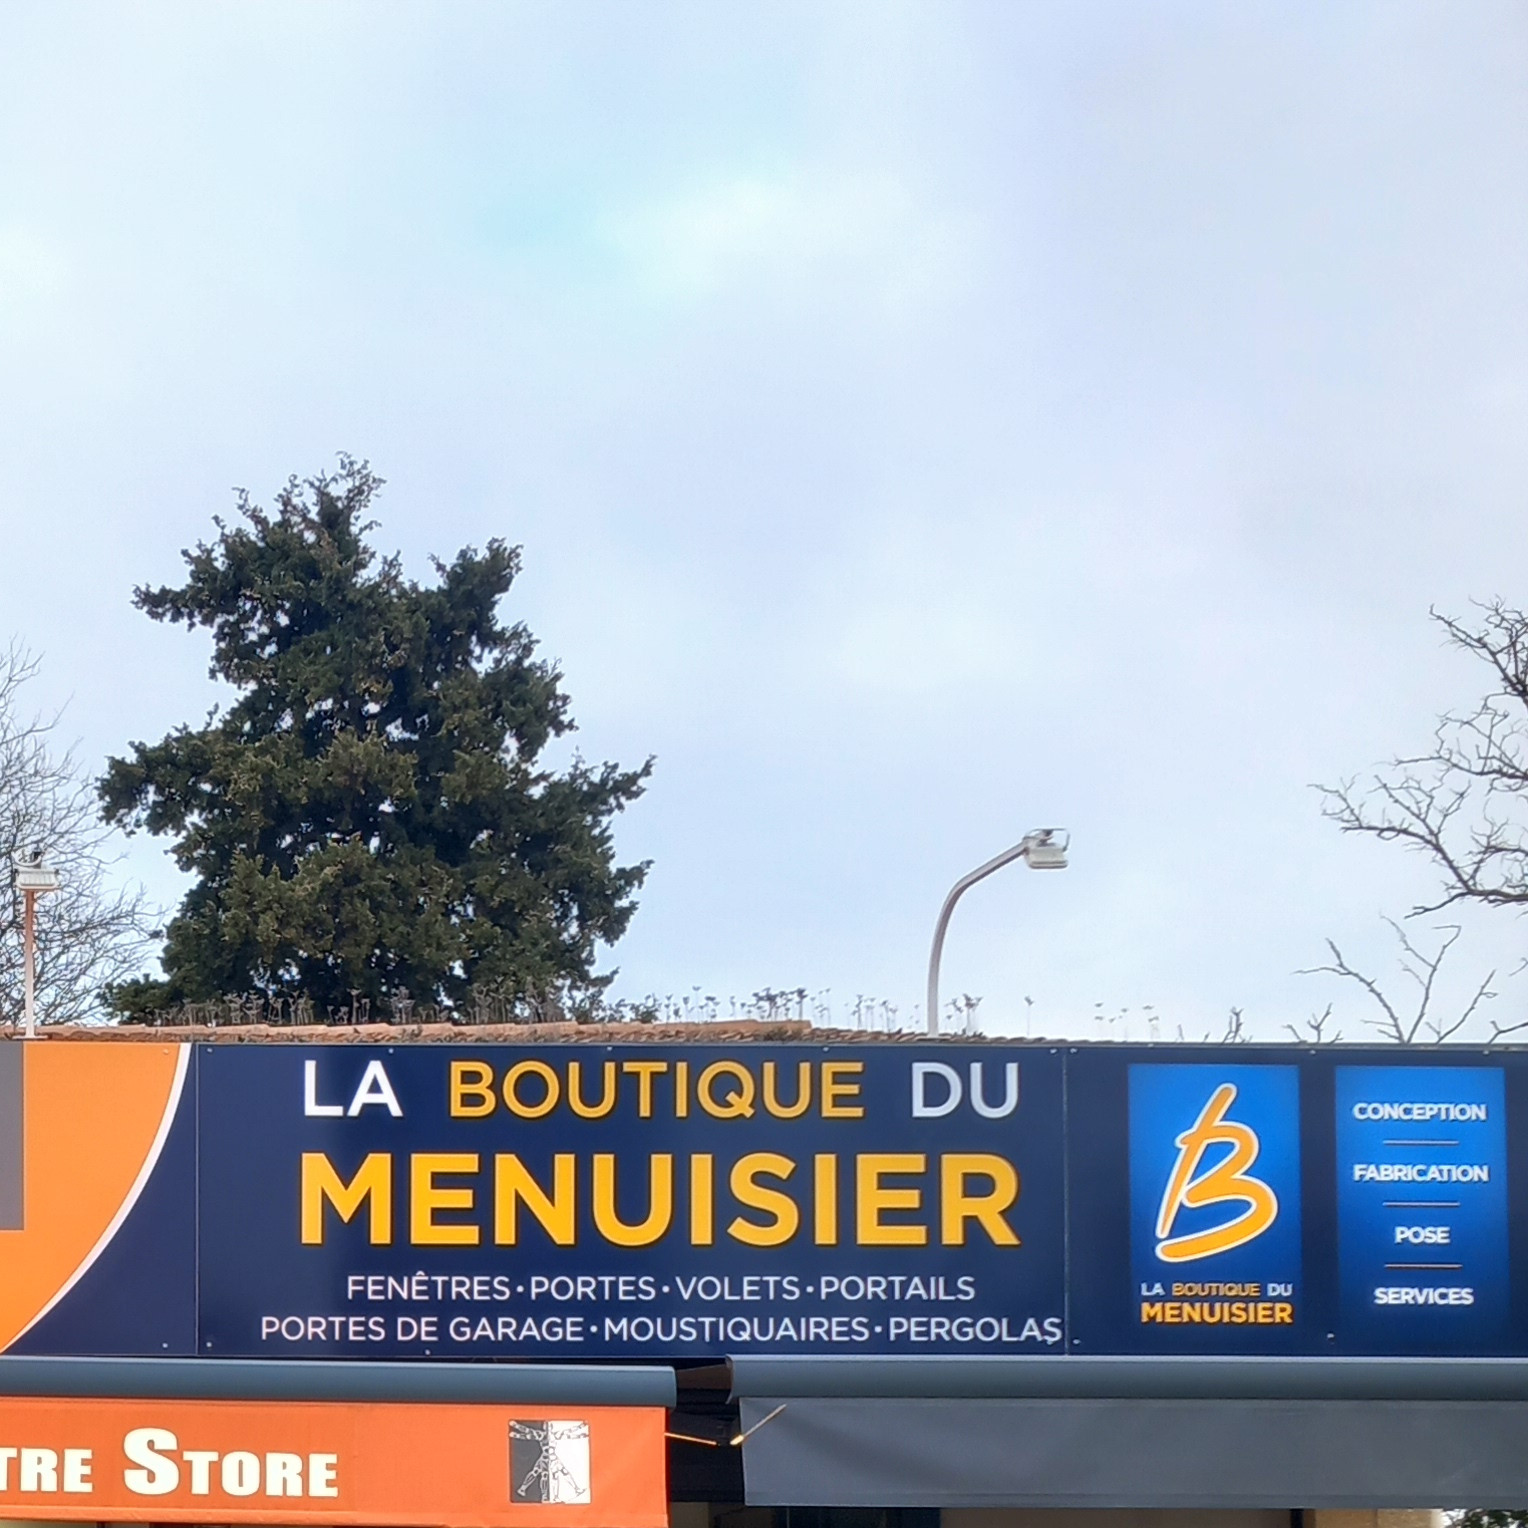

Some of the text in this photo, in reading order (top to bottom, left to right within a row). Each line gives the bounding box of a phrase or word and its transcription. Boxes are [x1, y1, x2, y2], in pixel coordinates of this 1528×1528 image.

[303, 1059, 1019, 1119] LA BOUTIQUE DU
[1353, 1103, 1486, 1121] CONCEPTION
[1353, 1164, 1489, 1182] FABRICATION
[299, 1151, 1022, 1246] MENUISIER
[1395, 1226, 1450, 1244] POSE
[820, 1275, 975, 1301] PORTAILS
[1141, 1282, 1293, 1297] LA BOUTIQUE DU
[1374, 1287, 1474, 1305] SERVICES
[1141, 1302, 1293, 1324] MENUISIER
[261, 1316, 385, 1341] PORTES
[397, 1316, 438, 1341] DE
[449, 1316, 584, 1342] GARAGE
[889, 1316, 1062, 1343] PERGOLAS
[123, 1427, 339, 1497] STORE
